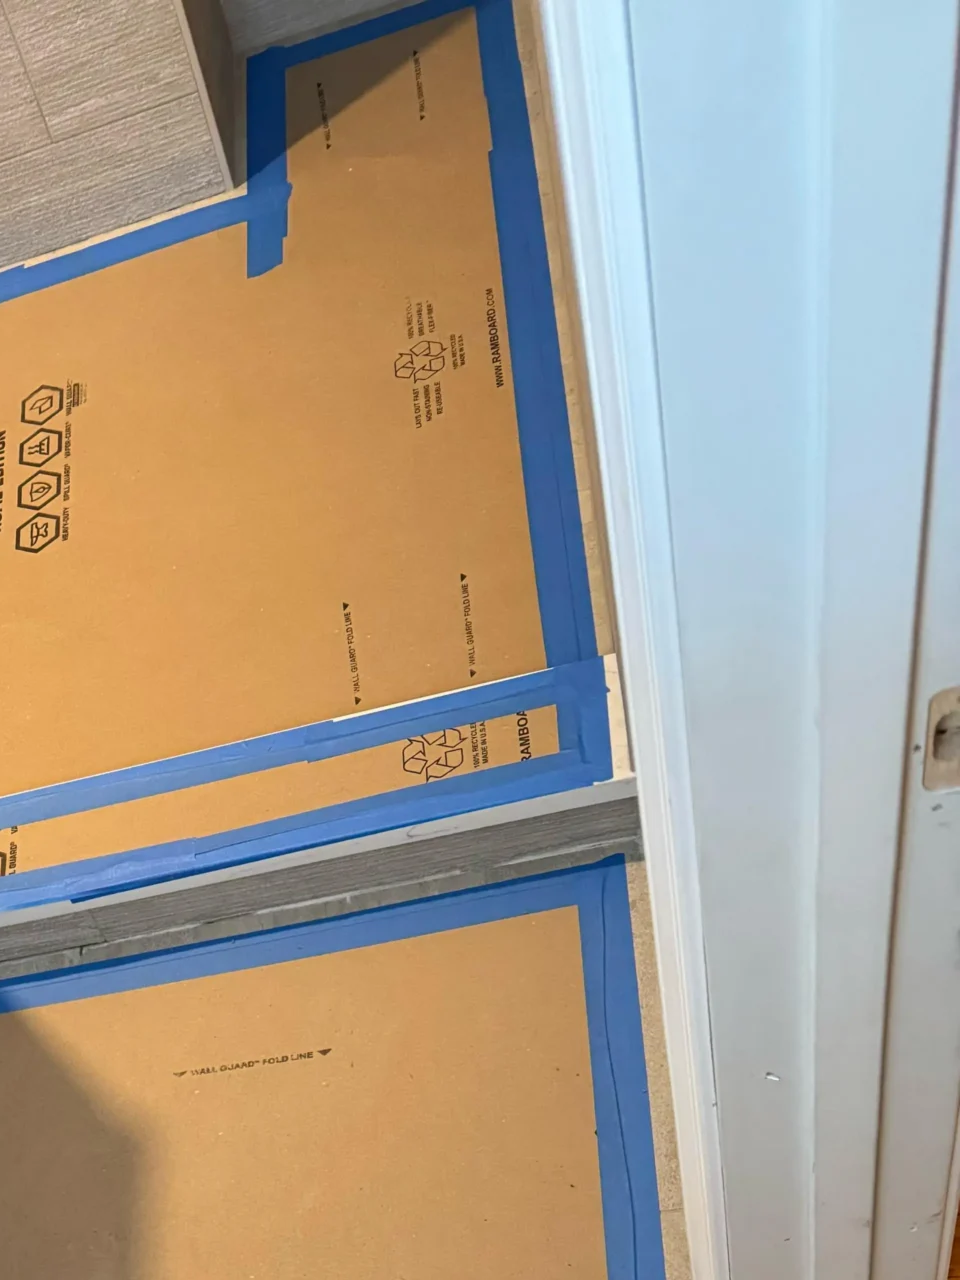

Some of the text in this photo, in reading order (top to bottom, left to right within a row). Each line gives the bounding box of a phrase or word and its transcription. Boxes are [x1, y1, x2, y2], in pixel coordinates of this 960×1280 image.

[486, 288, 504, 388] WWW.RAMBOARD.COM
[462, 583, 470, 598] LINE
[470, 722, 478, 754] RECYCLE
